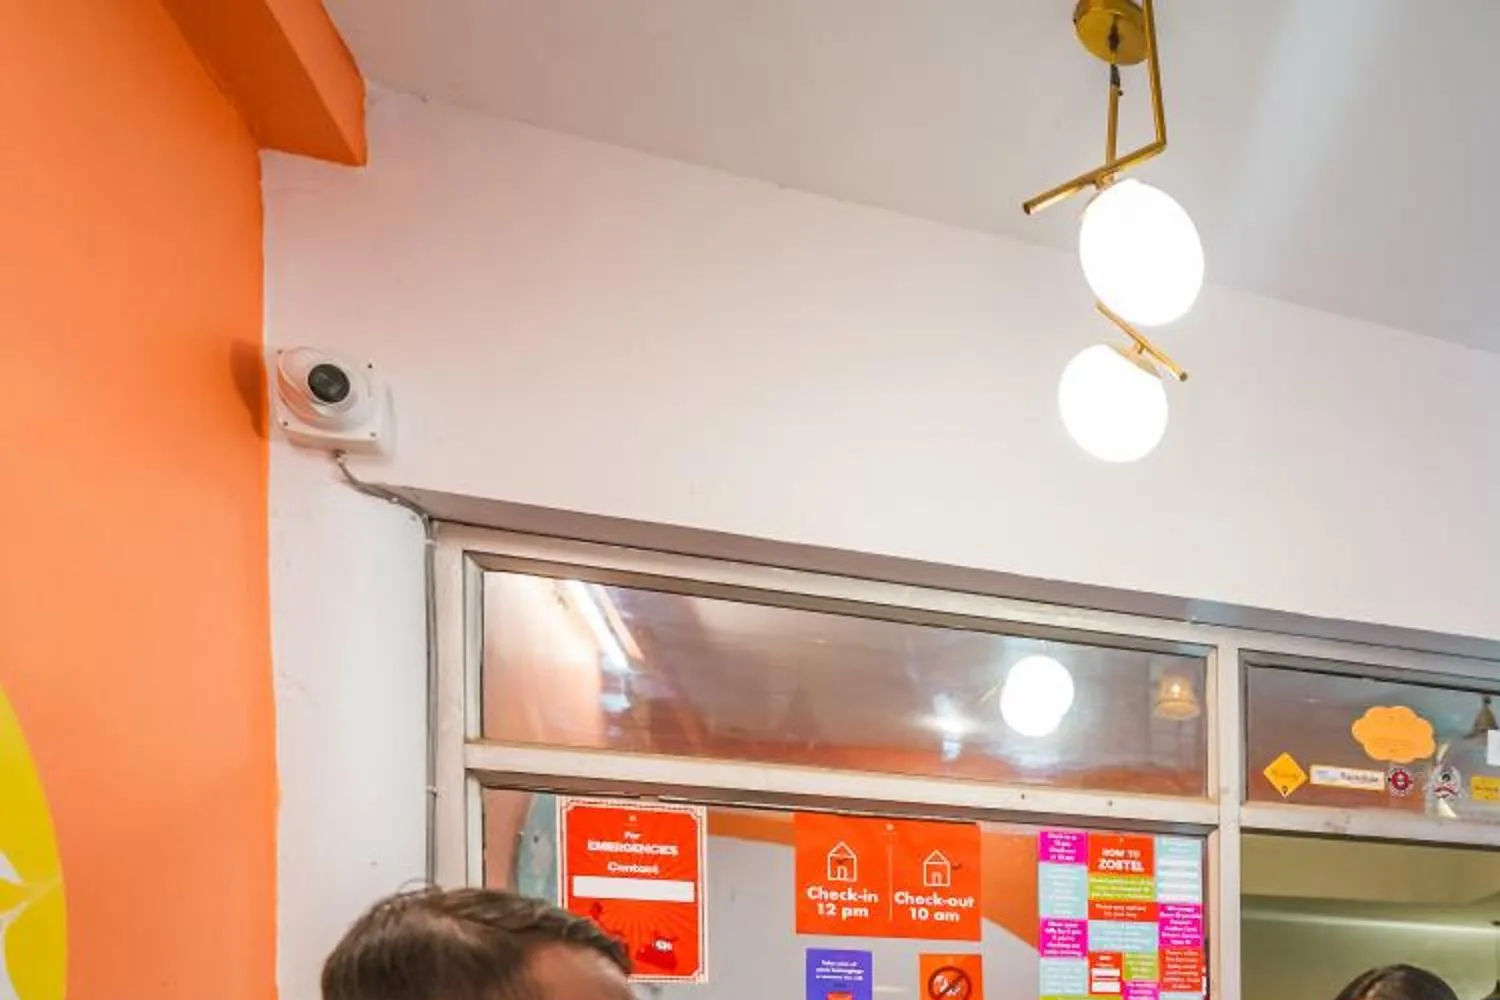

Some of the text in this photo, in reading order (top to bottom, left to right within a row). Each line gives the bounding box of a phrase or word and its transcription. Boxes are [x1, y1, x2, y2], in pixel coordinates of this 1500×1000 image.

[587, 840, 679, 857] EMERGENCIES
[1098, 859, 1145, 873] ZOSTEL
[807, 885, 879, 903] Check-in
[894, 891, 975, 908] Check-out
[817, 903, 869, 921] 12 pm
[909, 907, 960, 922] 10 am
